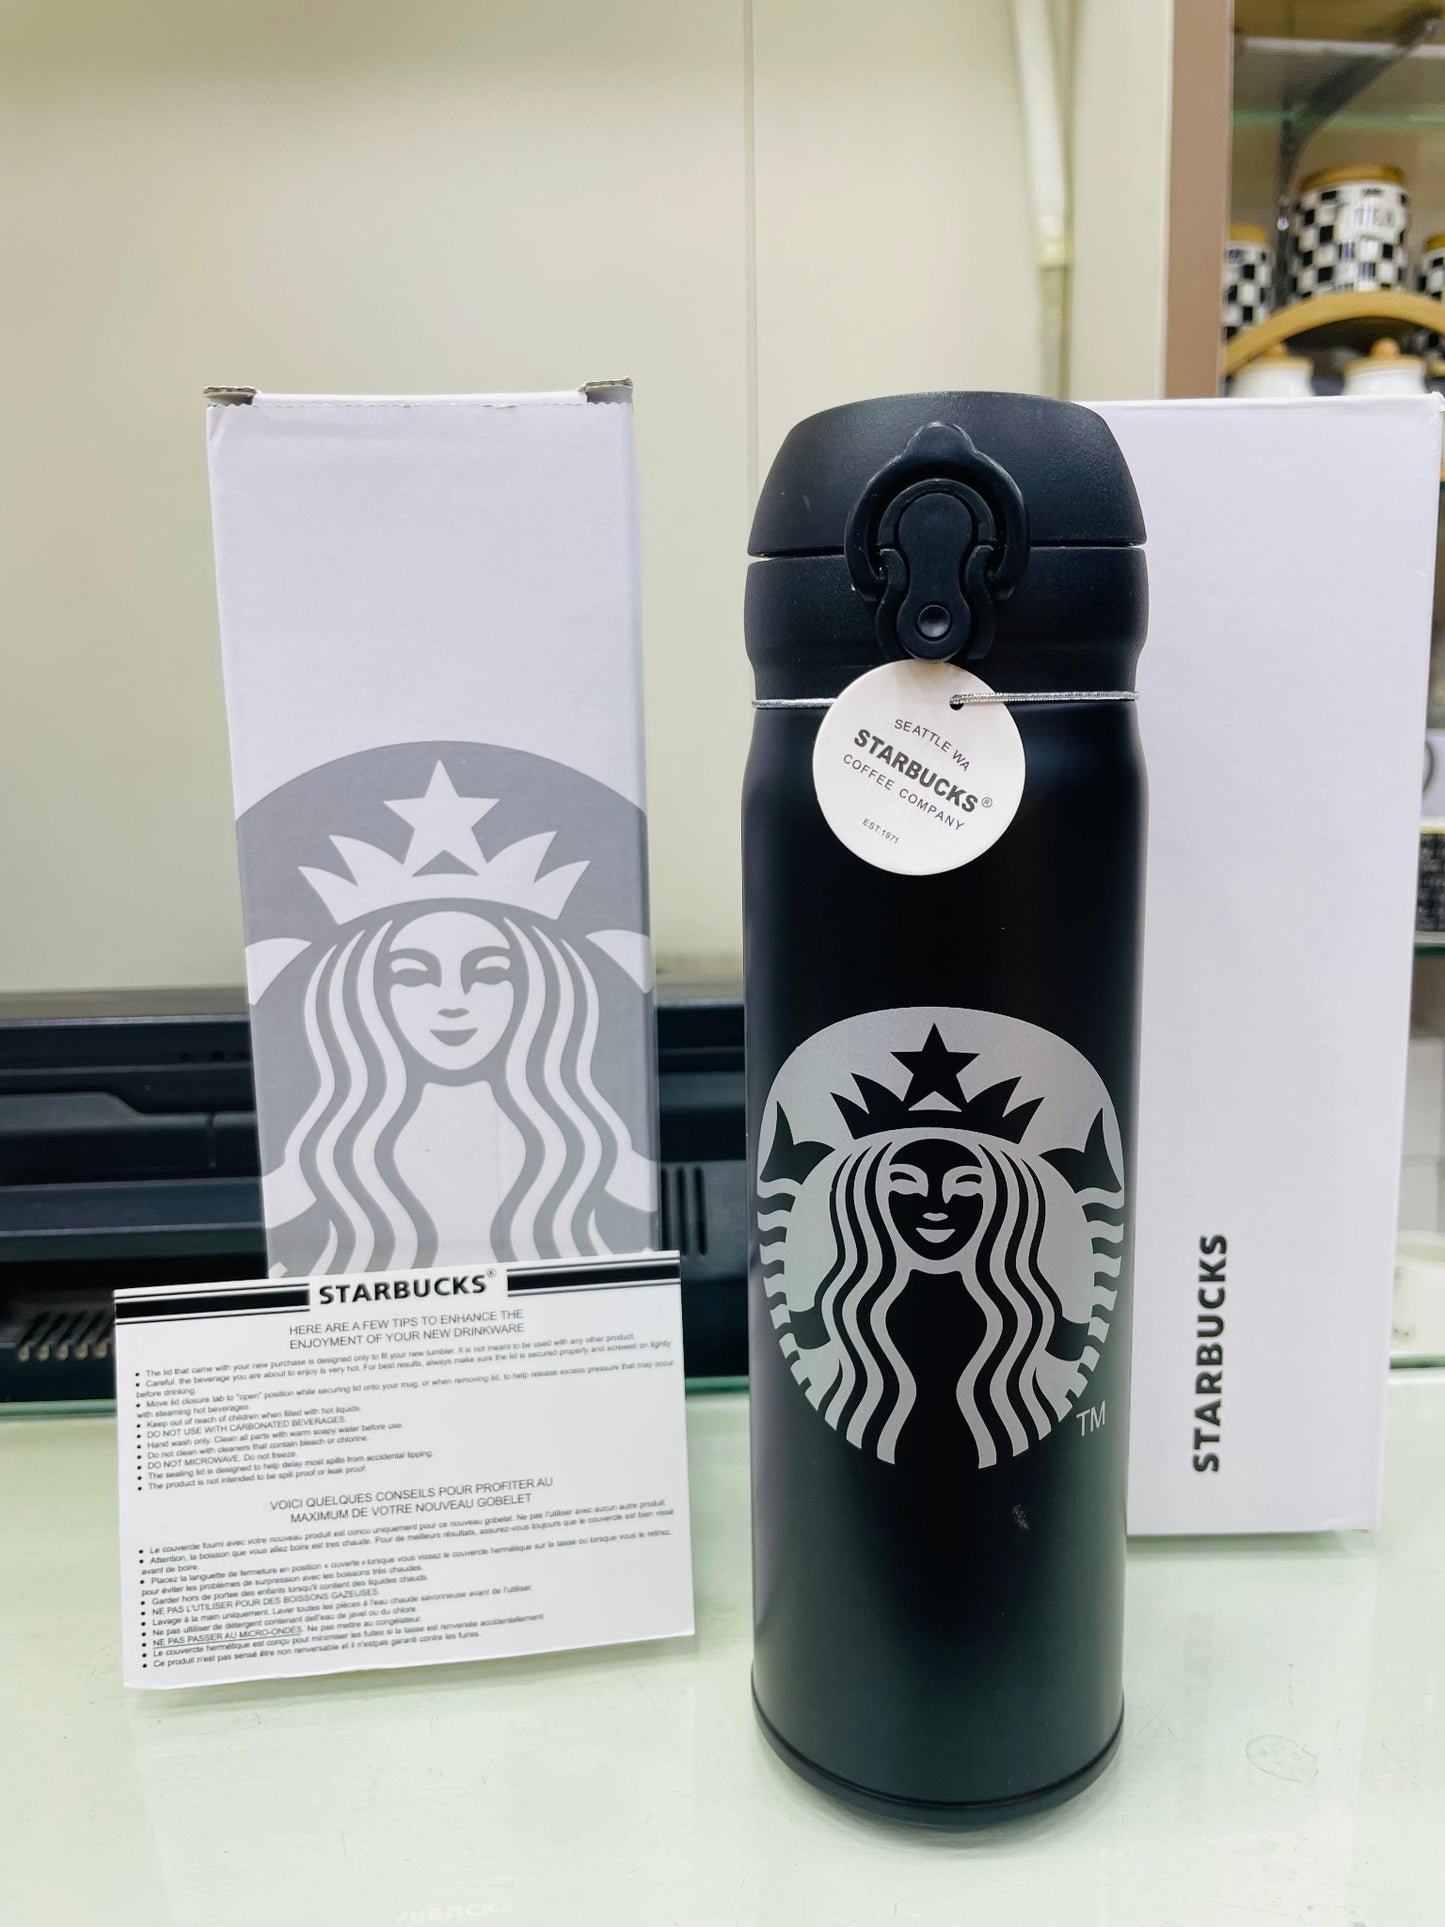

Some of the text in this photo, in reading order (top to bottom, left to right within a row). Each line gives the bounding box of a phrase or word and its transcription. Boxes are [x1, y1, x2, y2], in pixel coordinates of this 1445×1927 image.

[894, 718, 970, 771] SEATTLE WA
[843, 754, 965, 831] COFFEE COMPANY
[288, 1309, 523, 1335] HERE ARE A FEW TIPS TO ENHANCE THE
[289, 1323, 524, 1349] ENJOYMENT OF YOUR NEW DRINKWARE
[145, 1368, 161, 1376] The
[162, 1367, 172, 1375] lid
[173, 1366, 189, 1374] that
[190, 1365, 213, 1373] came
[214, 1363, 231, 1371] with
[232, 1363, 250, 1371] your
[269, 1358, 306, 1369] purchase
[316, 1354, 352, 1364] designed
[353, 1353, 369, 1361] only
[380, 1351, 388, 1359] fit
[389, 1351, 406, 1360] your
[1193, 1234, 1228, 1473] STARBUCKS
[135, 1390, 161, 1398] before
[136, 1410, 153, 1418] with
[154, 1407, 191, 1417] steaming
[192, 1406, 205, 1414] hot
[146, 1420, 168, 1428] Keep
[169, 1417, 182, 1425] out
[193, 1415, 216, 1423] reach
[218, 1414, 226, 1422] of
[227, 1412, 259, 1421] children
[260, 1410, 282, 1418] when
[283, 1408, 302, 1416] filled
[303, 1407, 319, 1415] with
[321, 1406, 333, 1414] hot
[1076, 1399, 1107, 1436] TM
[146, 1430, 161, 1438] DO
[162, 1428, 180, 1436] NOT
[183, 1426, 201, 1435] USE
[204, 1424, 227, 1433] WITH
[228, 1419, 290, 1431] CARBONATED
[146, 1439, 169, 1448] Hand
[170, 1437, 192, 1446] wash
[213, 1435, 237, 1443] Clean
[239, 1433, 248, 1441] all
[249, 1432, 270, 1441] parts
[271, 1430, 288, 1438] with
[289, 1429, 311, 1437] warm
[312, 1427, 336, 1435] soapy
[337, 1425, 359, 1433] water
[360, 1423, 385, 1431] before
[146, 1451, 159, 1459] Do
[160, 1449, 174, 1457] not
[198, 1446, 215, 1454] with
[217, 1444, 250, 1453] cleaners
[252, 1442, 267, 1450] that
[268, 1440, 297, 1449] contain
[299, 1437, 325, 1446] bleach
[147, 1460, 161, 1468] DO
[162, 1459, 181, 1467] NOT
[243, 1453, 255, 1461] Do
[256, 1452, 269, 1460] not
[147, 1471, 163, 1479] The
[165, 1469, 194, 1478] sealing
[195, 1467, 205, 1475] lid
[215, 1464, 251, 1474] designed
[262, 1462, 280, 1470] help
[281, 1460, 302, 1468] delay
[304, 1458, 324, 1466] most
[325, 1456, 345, 1466] spills
[346, 1455, 364, 1463] from
[366, 1451, 405, 1461] accidental
[148, 1481, 163, 1489] The
[165, 1478, 195, 1489] product
[205, 1476, 219, 1484] not
[220, 1473, 255, 1483] intended
[278, 1470, 293, 1480] spill
[294, 1468, 315, 1479] proof
[327, 1466, 343, 1474] leak
[270, 1477, 553, 1510] VOICI QUELQUES CONSEILS POUR PROFITER AU
[290, 1493, 533, 1523] MAXIMUM DE VOTRE NOUVEAU GOBELET
[151, 1607, 164, 1615] NE
[166, 1605, 184, 1614] PAS
[234, 1598, 260, 1608] POUR
[262, 1596, 281, 1605] DES
[282, 1592, 328, 1603] BOISSONS
